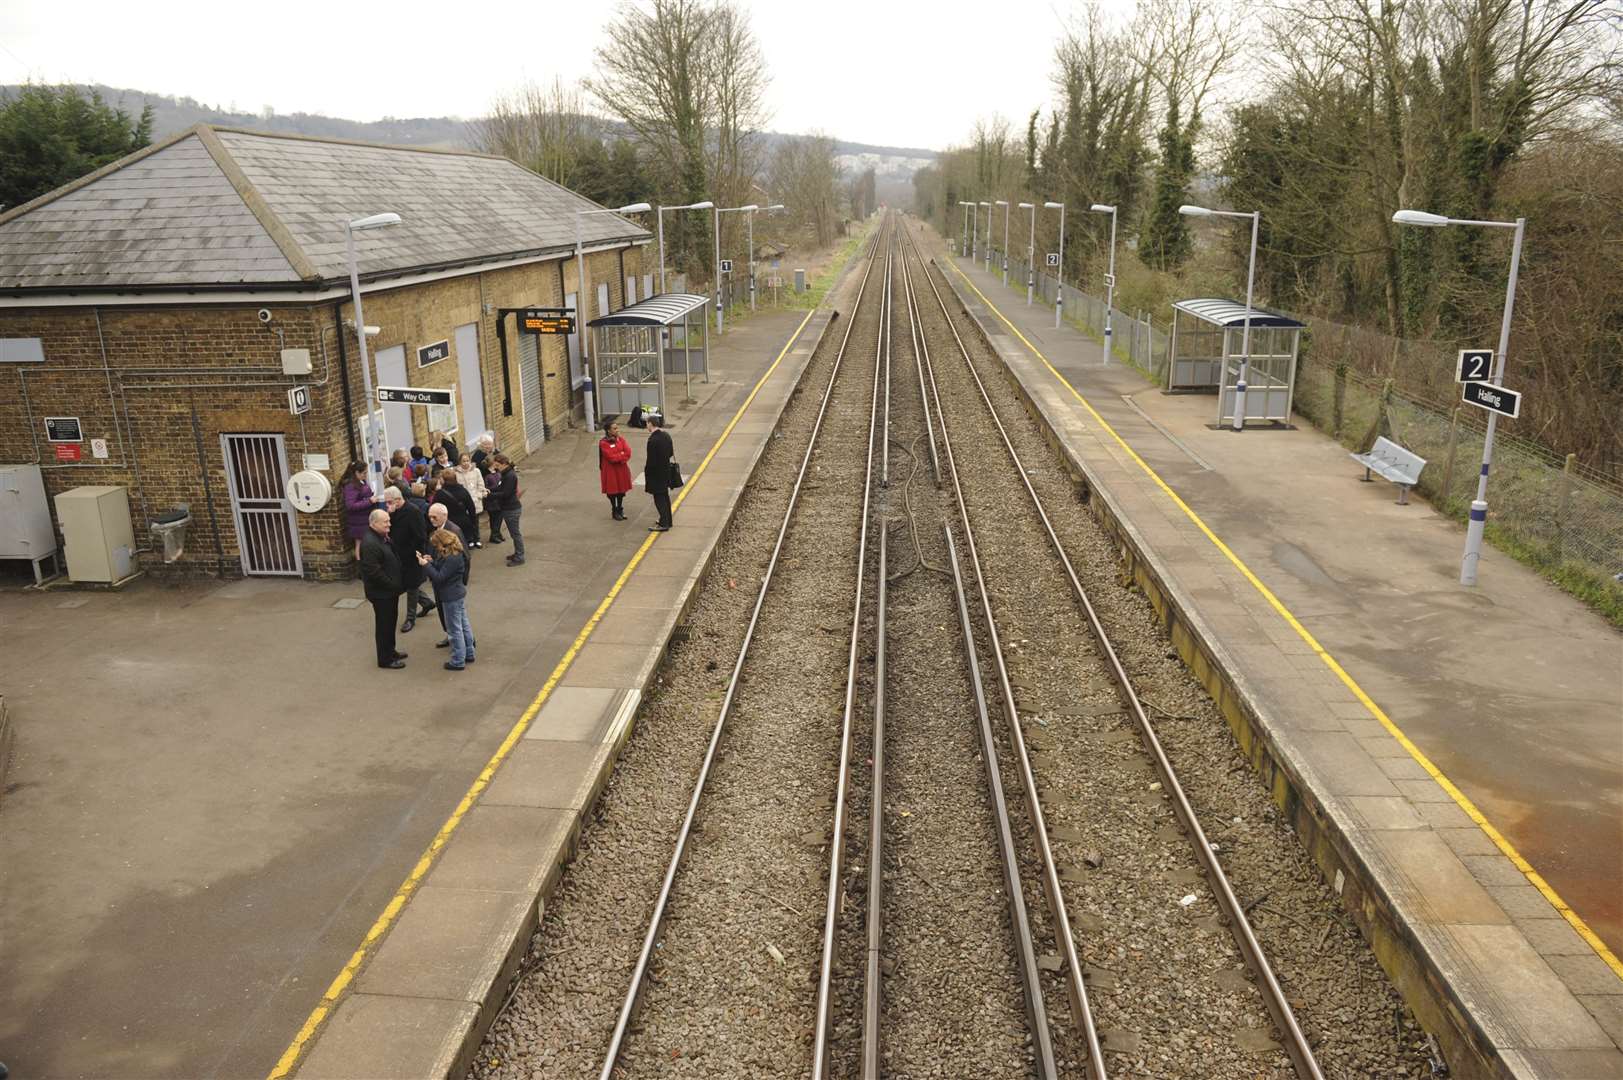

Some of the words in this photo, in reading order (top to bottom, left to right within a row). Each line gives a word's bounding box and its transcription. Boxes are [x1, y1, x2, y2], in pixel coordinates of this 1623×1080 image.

[1468, 356, 1483, 378] 2
[402, 392, 417, 402] Way
[1478, 388, 1501, 408] Halling
